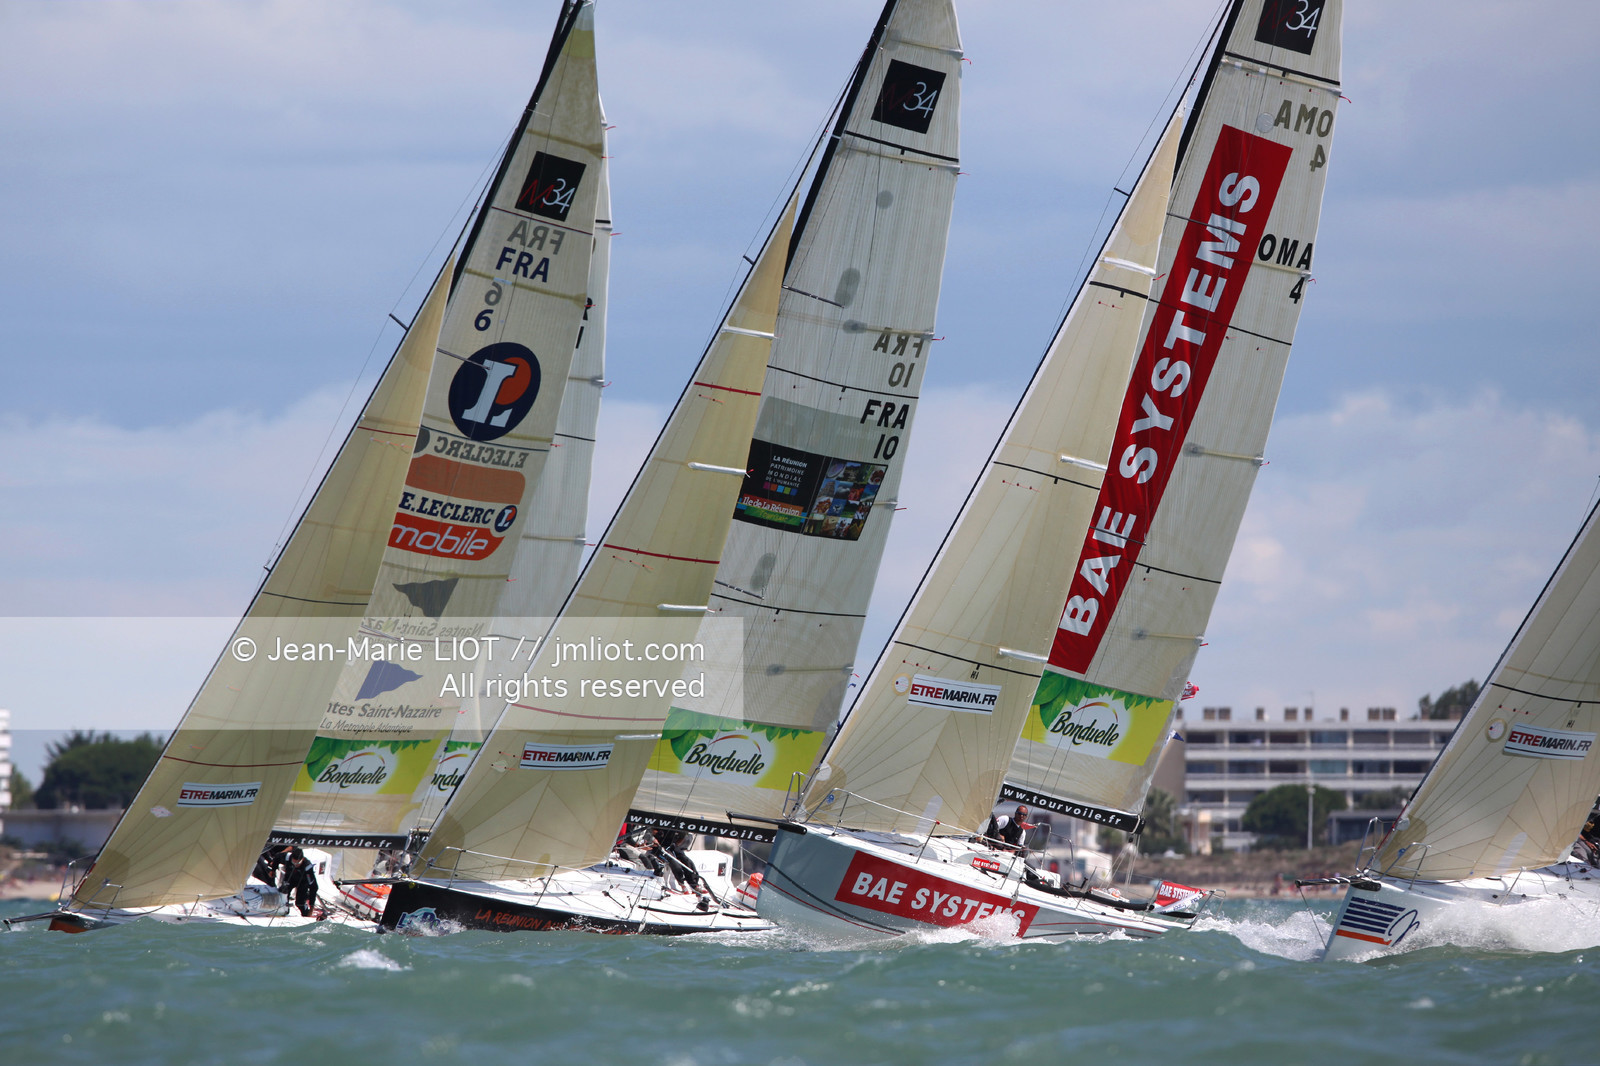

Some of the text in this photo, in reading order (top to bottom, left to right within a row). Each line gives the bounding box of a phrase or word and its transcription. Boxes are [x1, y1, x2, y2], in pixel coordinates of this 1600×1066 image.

[518, 178, 576, 213] M34
[495, 247, 550, 283] FRA
[1258, 234, 1313, 270] OMA
[1289, 277, 1305, 304] 4
[474, 309, 494, 331] 6
[860, 399, 909, 429] FRA
[1060, 172, 1260, 636] BAE SYSTEMS
[873, 434, 899, 460] 10
[767, 470, 802, 482] MONDIAL
[770, 463, 804, 475] PATRIMOINE
[398, 492, 495, 524] E.LECLERC
[392, 523, 489, 556] mobile
[910, 684, 998, 706] ETREMARIN.FR
[358, 702, 442, 718] Saint-Nazaire
[1050, 711, 1119, 746] Bonduelle
[1508, 731, 1592, 752] ETREMARIN.FR
[522, 750, 611, 763] ETREMARIN.FR
[685, 742, 766, 777] Bonduelle
[317, 763, 387, 790] Bonduelle
[180, 788, 258, 800] ETREMARIN.FR
[266, 836, 392, 849] ww.tourvoile.fr
[852, 872, 908, 905] BAE
[1159, 884, 1172, 897] BAE
[475, 909, 492, 923] LA
